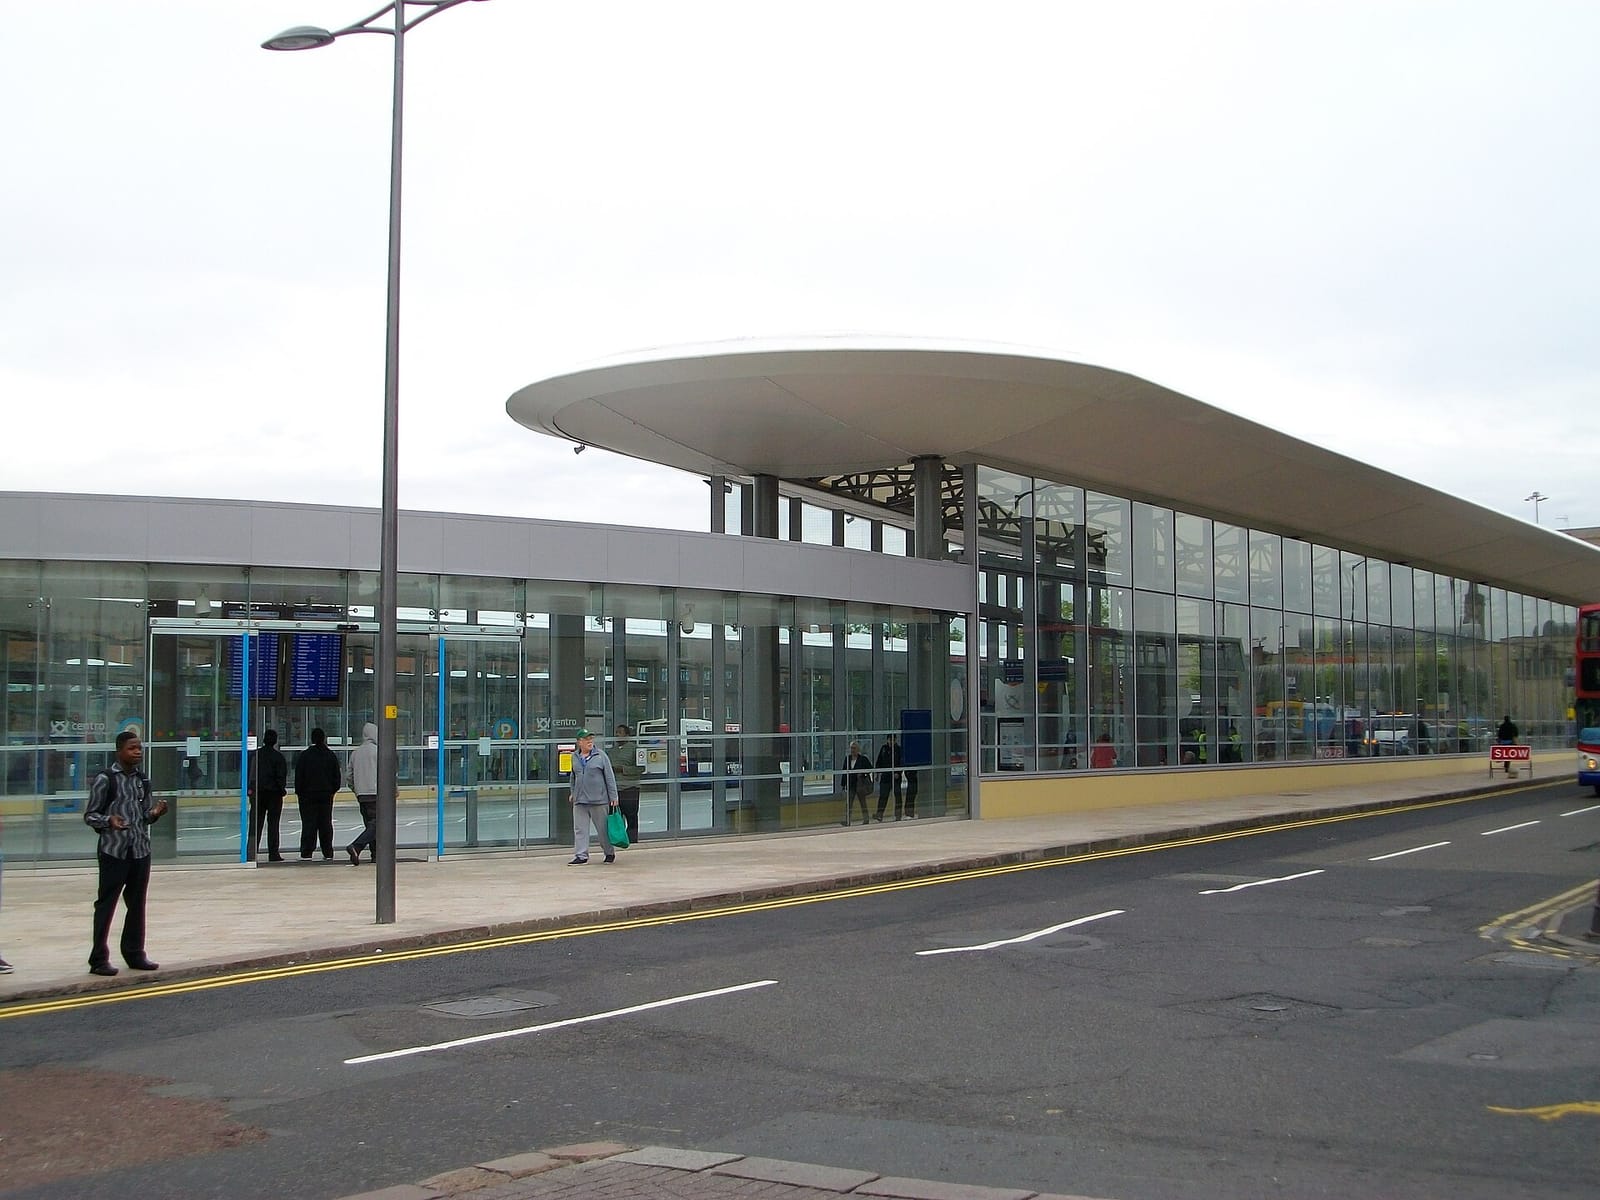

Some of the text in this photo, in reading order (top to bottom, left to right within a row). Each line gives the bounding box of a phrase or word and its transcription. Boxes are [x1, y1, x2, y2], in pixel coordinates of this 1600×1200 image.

[71, 721, 105, 731] centro
[552, 718, 577, 726] centro
[1495, 749, 1529, 758] SLOW
